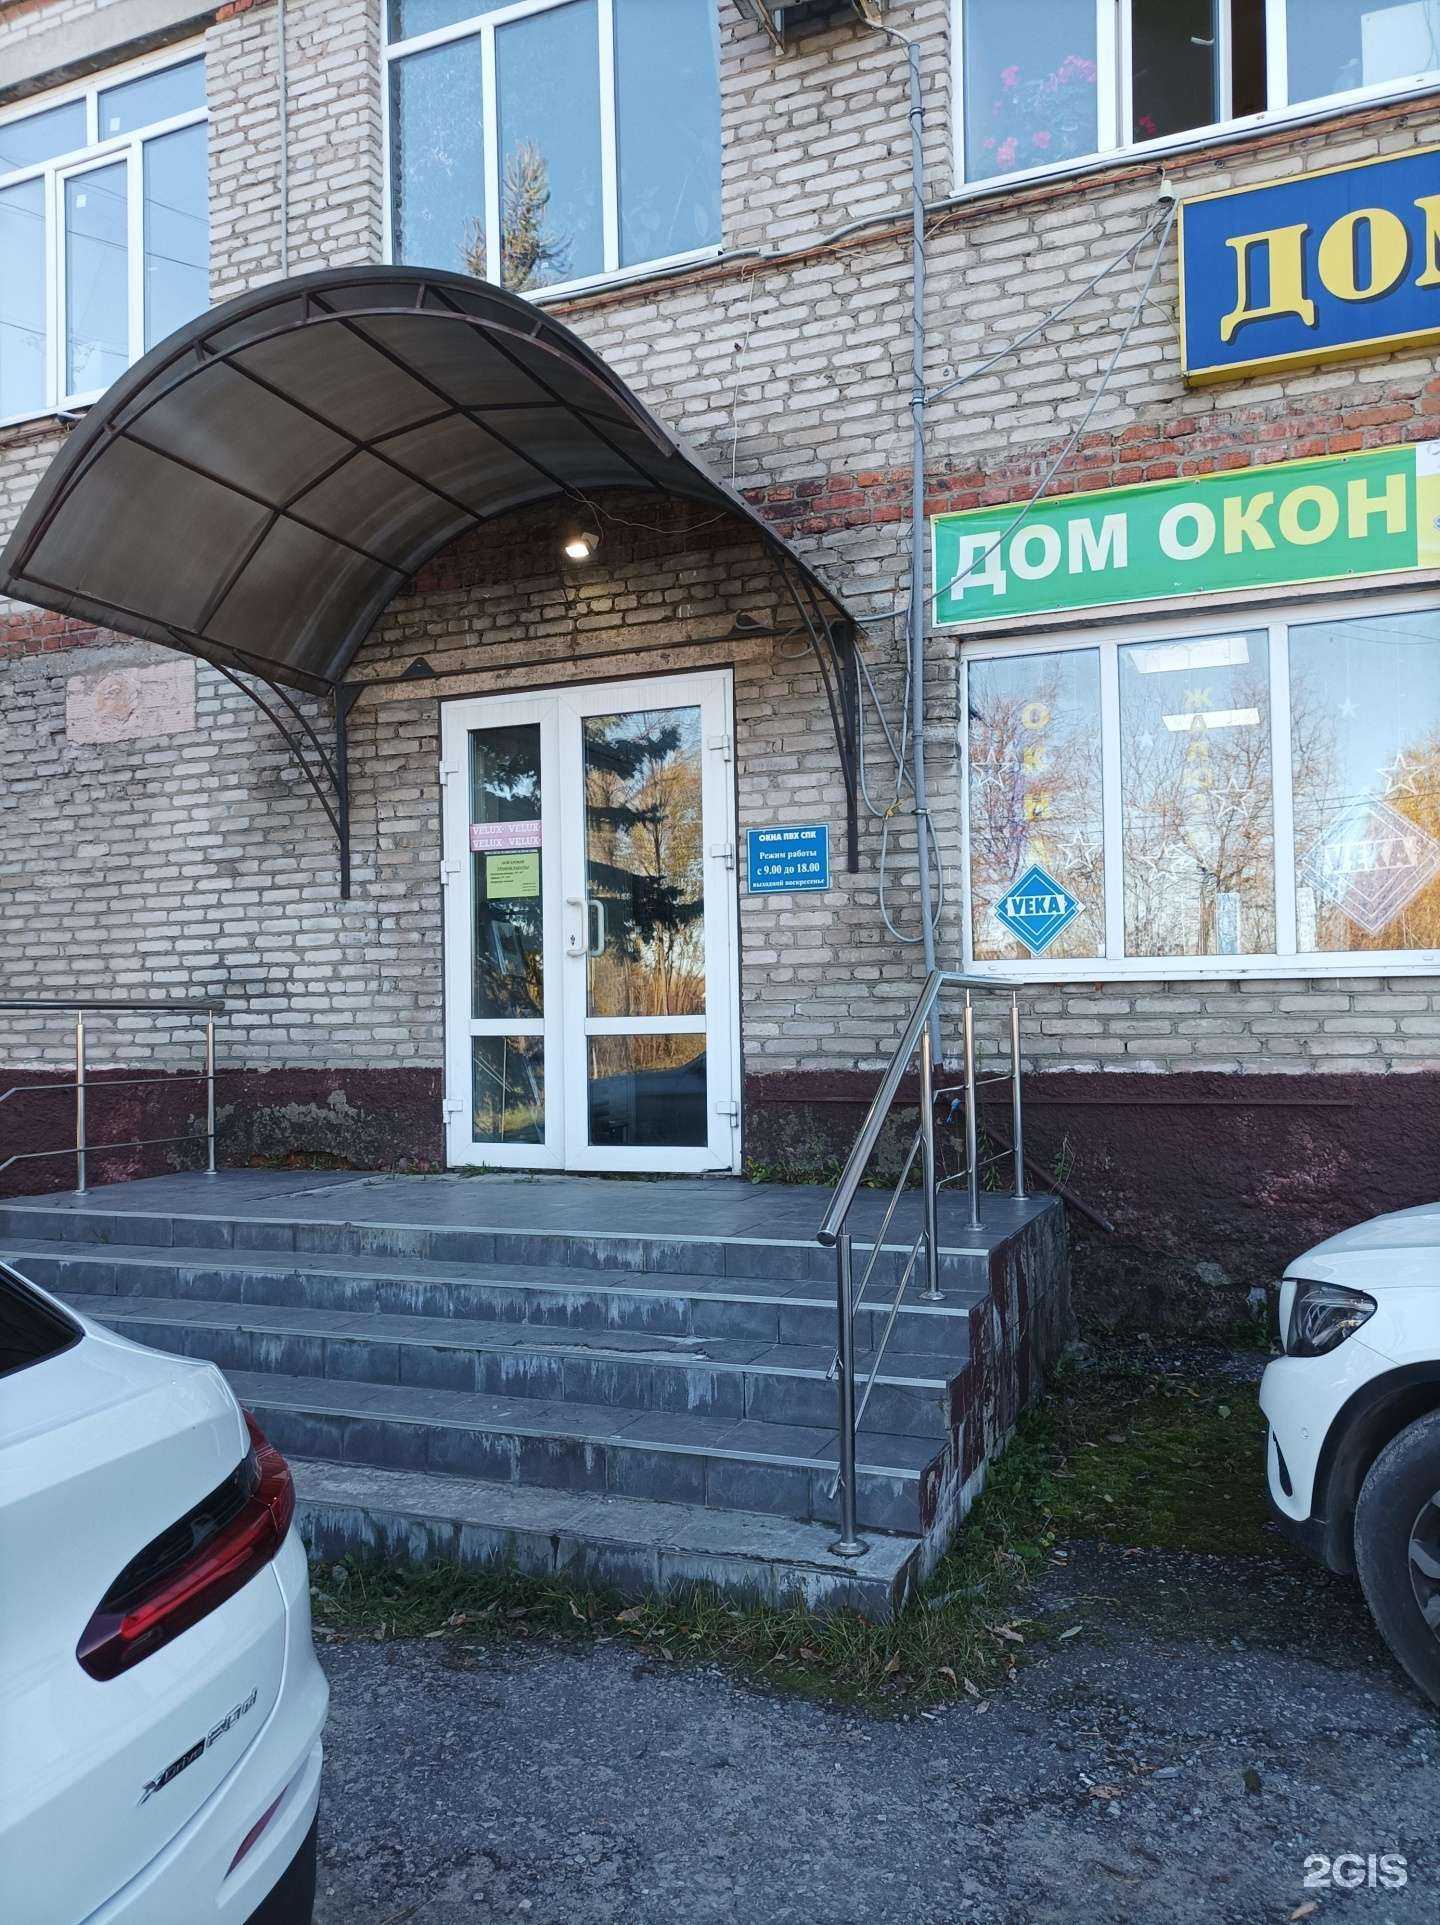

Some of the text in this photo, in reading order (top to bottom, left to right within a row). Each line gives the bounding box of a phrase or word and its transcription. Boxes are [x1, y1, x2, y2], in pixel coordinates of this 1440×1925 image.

[1220, 195, 1440, 342] ДО
[950, 472, 1408, 601] ДОМ ОКОН
[759, 833, 782, 842] ОКНА
[783, 832, 800, 841] ПВХ
[759, 850, 817, 860] Режим работы
[757, 868, 762, 876] с
[763, 864, 782, 875] 9.00
[797, 862, 820, 873] 18.00
[1011, 896, 1062, 915] VEKA
